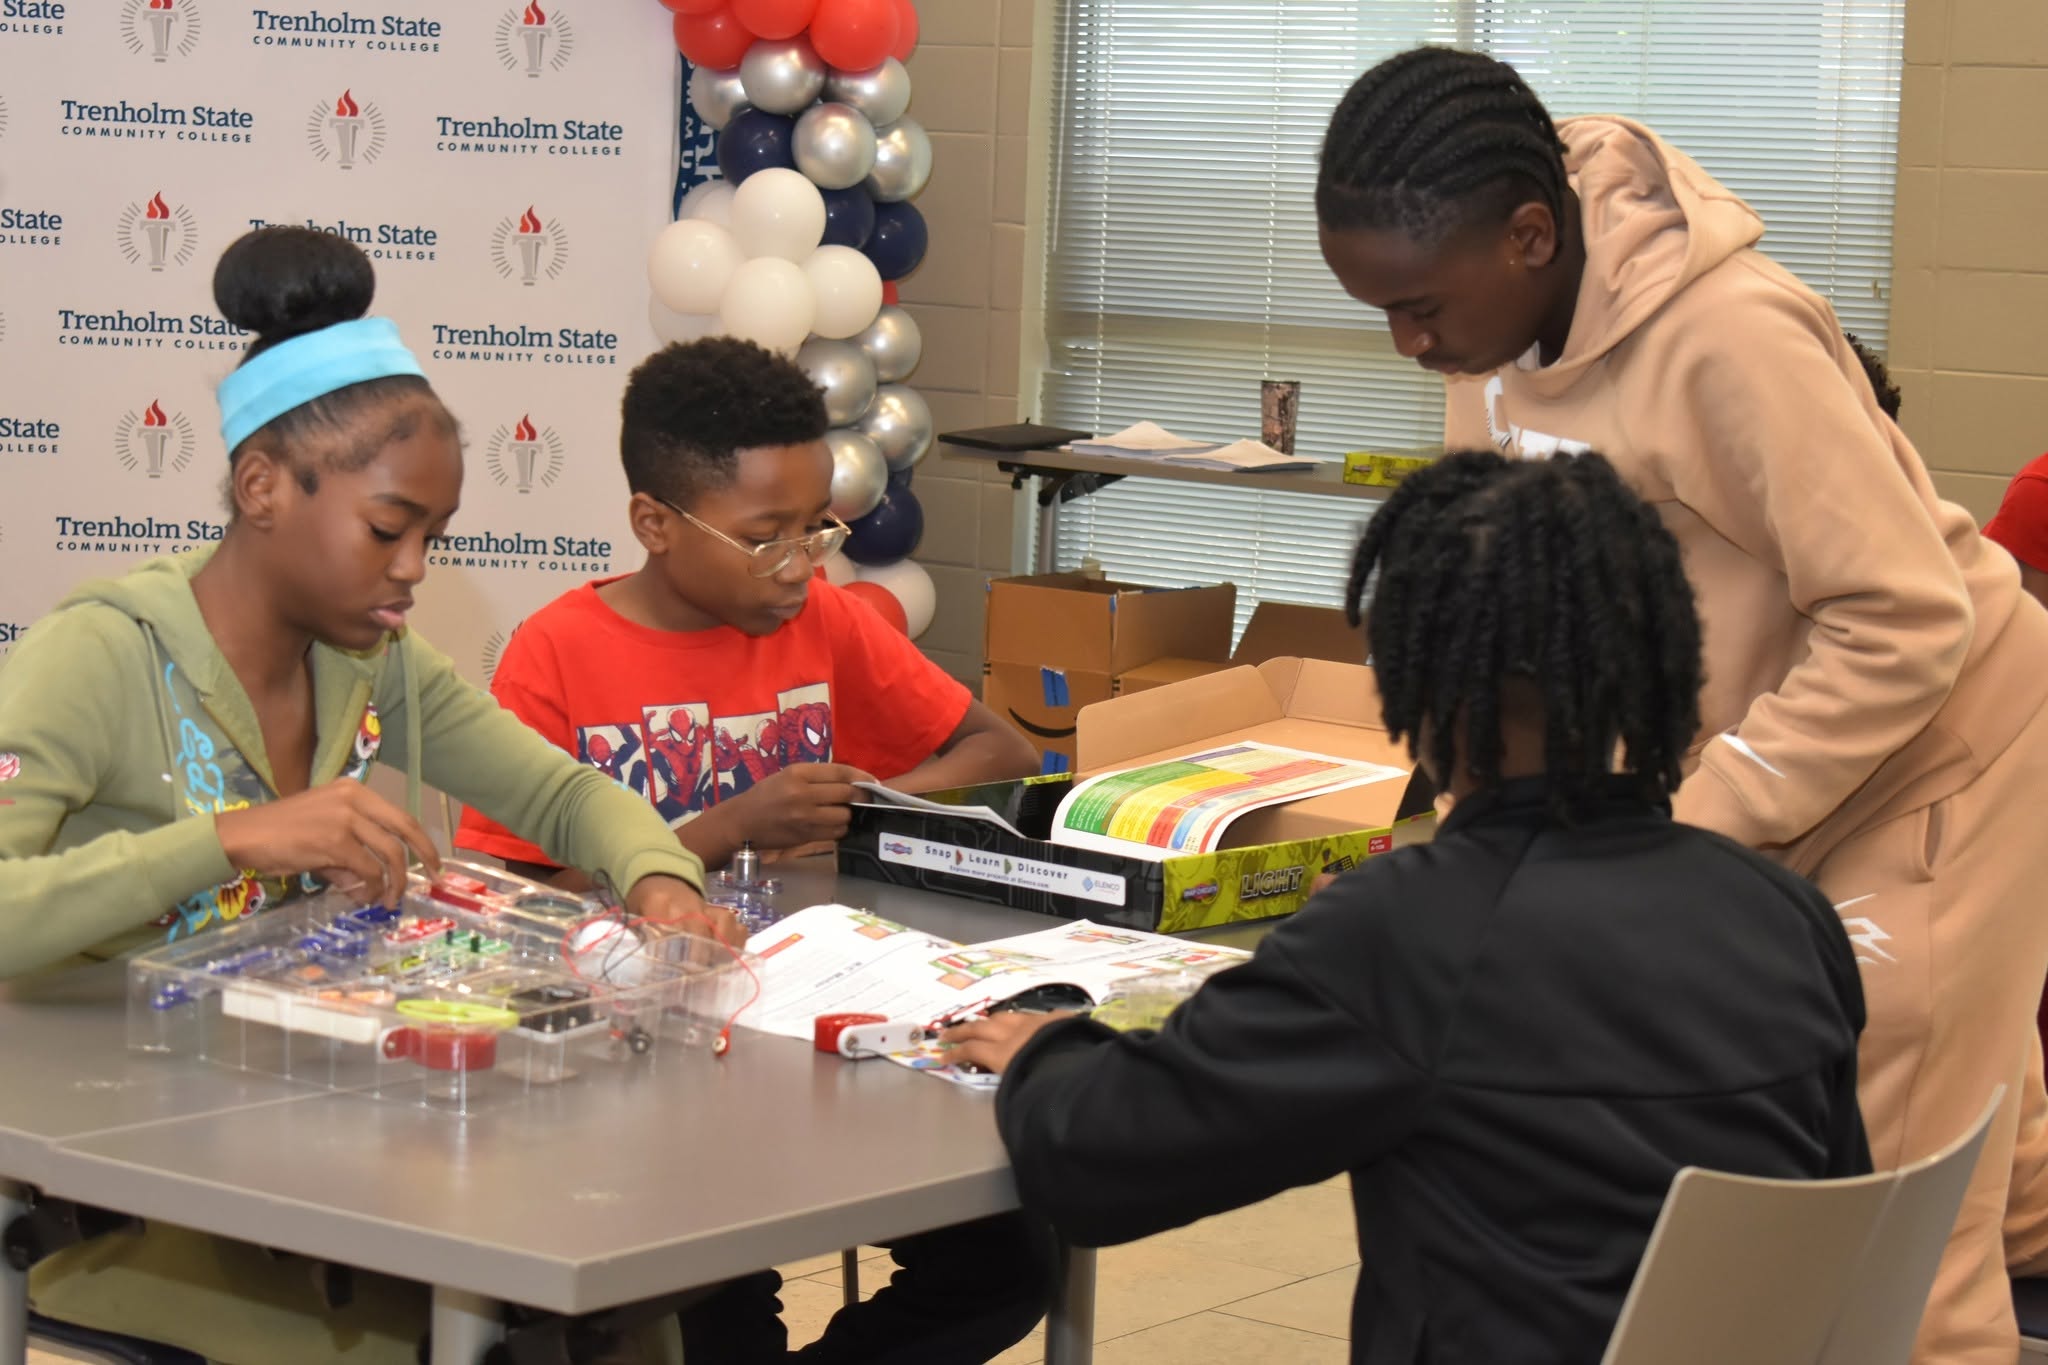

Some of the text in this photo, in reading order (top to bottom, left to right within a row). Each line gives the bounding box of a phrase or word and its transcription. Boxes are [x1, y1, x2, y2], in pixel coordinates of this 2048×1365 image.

[3, 0, 65, 20] State
[0, 23, 63, 35] OLLEGE
[253, 10, 441, 38] Trenholm State
[253, 36, 440, 52] COMMUNITY COLLEGE
[61, 100, 253, 129] Trenholm State
[61, 125, 252, 143] COMMUNITY COLLEGE
[437, 116, 623, 142] Trenholm State
[436, 141, 622, 156] COMMUNITY COLLEGE
[1, 208, 62, 231] State
[0, 234, 61, 246] OLLEGE
[377, 224, 437, 246] State
[58, 309, 184, 334] Trenholm
[58, 335, 249, 351] COMMUNITY COLLEGE
[433, 325, 617, 350] Trenholm State
[432, 349, 617, 365] COMMUNITY COLLEGE
[0, 417, 60, 439] State
[56, 516, 228, 541] Trenholm Sta
[56, 541, 161, 554] COMMUNITY
[553, 536, 611, 558] State
[429, 555, 610, 573] COMMUNITY COLLEGE
[925, 845, 952, 859] Snap
[968, 853, 1000, 867] Learn
[1017, 862, 1069, 880] Discover
[1094, 880, 1120, 891] ELENCO
[1240, 866, 1305, 899] LIGHT
